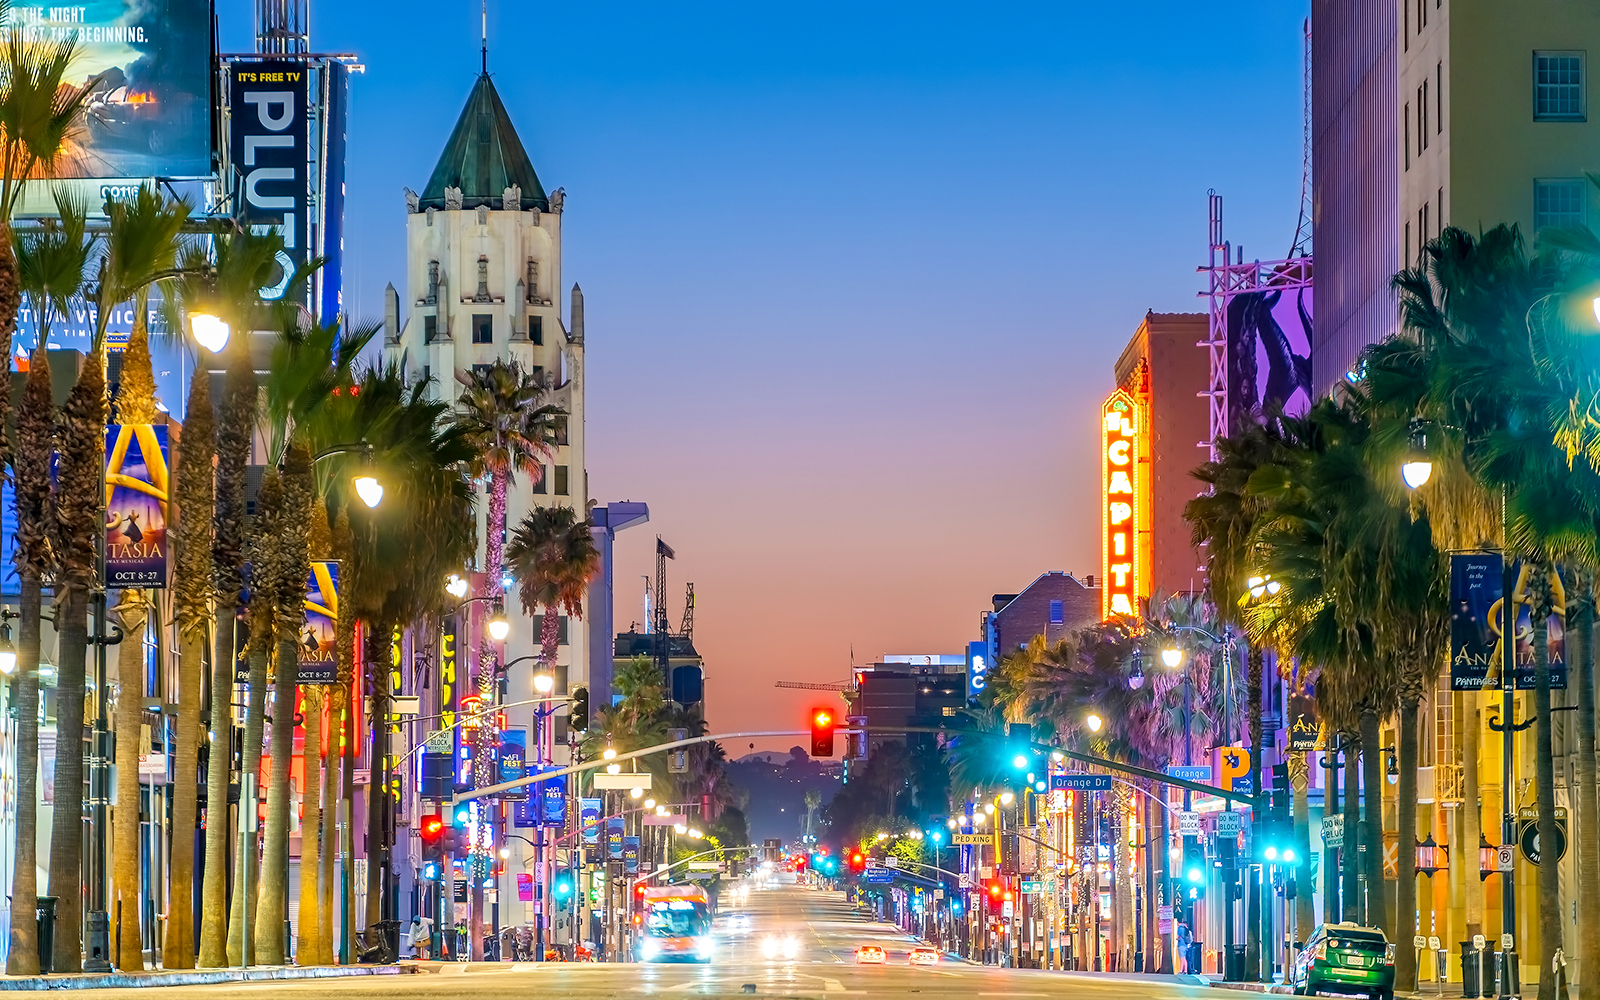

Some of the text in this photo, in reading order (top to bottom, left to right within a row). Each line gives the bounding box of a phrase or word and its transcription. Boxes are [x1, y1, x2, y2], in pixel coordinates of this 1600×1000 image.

[22, 7, 44, 23] THE
[49, 7, 86, 23] NIGHT
[16, 26, 45, 43] UST
[51, 26, 73, 43] THE
[78, 26, 149, 43] BEGINNING.
[238, 72, 300, 82] IT'S FREE TV
[1107, 440, 1134, 616] CAPITA
[106, 543, 163, 558] TASIA
[1466, 563, 1487, 571] Journey
[115, 572, 157, 580] OCT 8-27
[300, 651, 334, 662] ASIA
[1455, 677, 1498, 686] PANTAGES
[1175, 769, 1205, 779] Orange
[1056, 778, 1107, 789] Orange Dr
[1220, 823, 1240, 831] BLOCK
[1323, 817, 1344, 829] DO NO
[1325, 828, 1344, 839] BLOC
[955, 835, 970, 843] PED
[1376, 956, 1385, 964] 131
